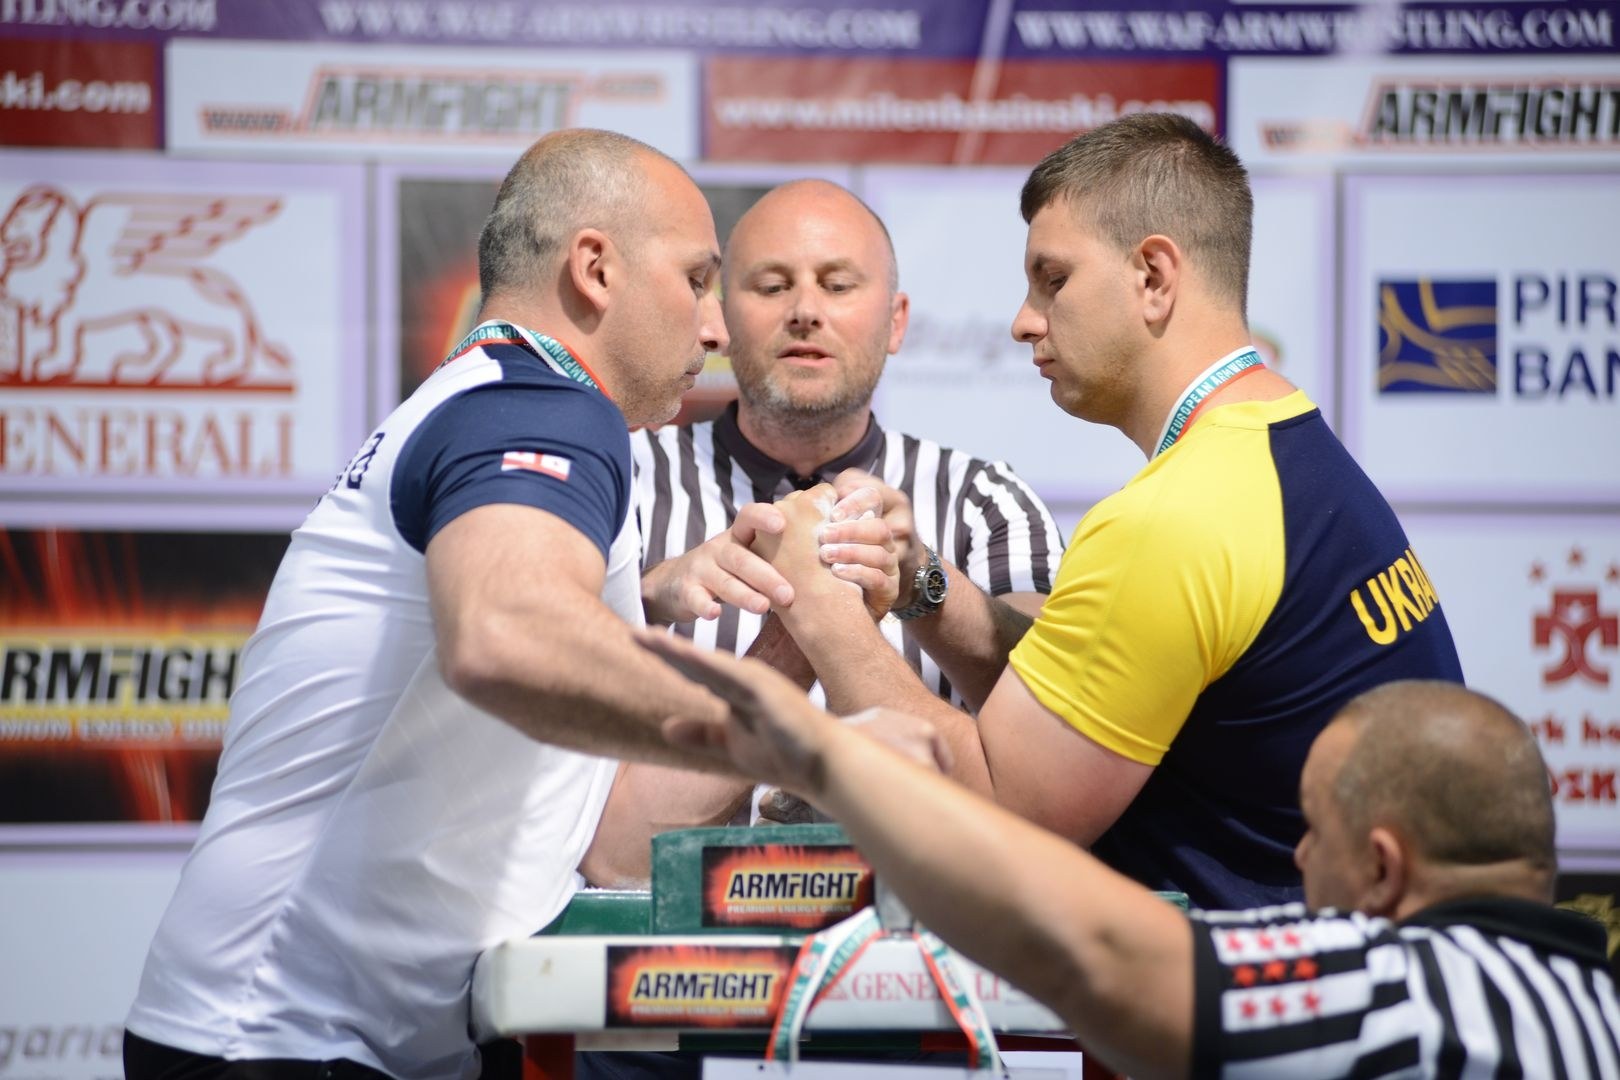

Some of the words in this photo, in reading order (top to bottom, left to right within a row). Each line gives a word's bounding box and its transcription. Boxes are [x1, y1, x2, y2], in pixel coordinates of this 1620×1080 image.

[1170, 381, 1214, 436] EUROPEAN
[1350, 545, 1439, 645] UKRA
[729, 872, 859, 899] ARMFIGHT
[635, 972, 773, 1000] ARMFIGHT
